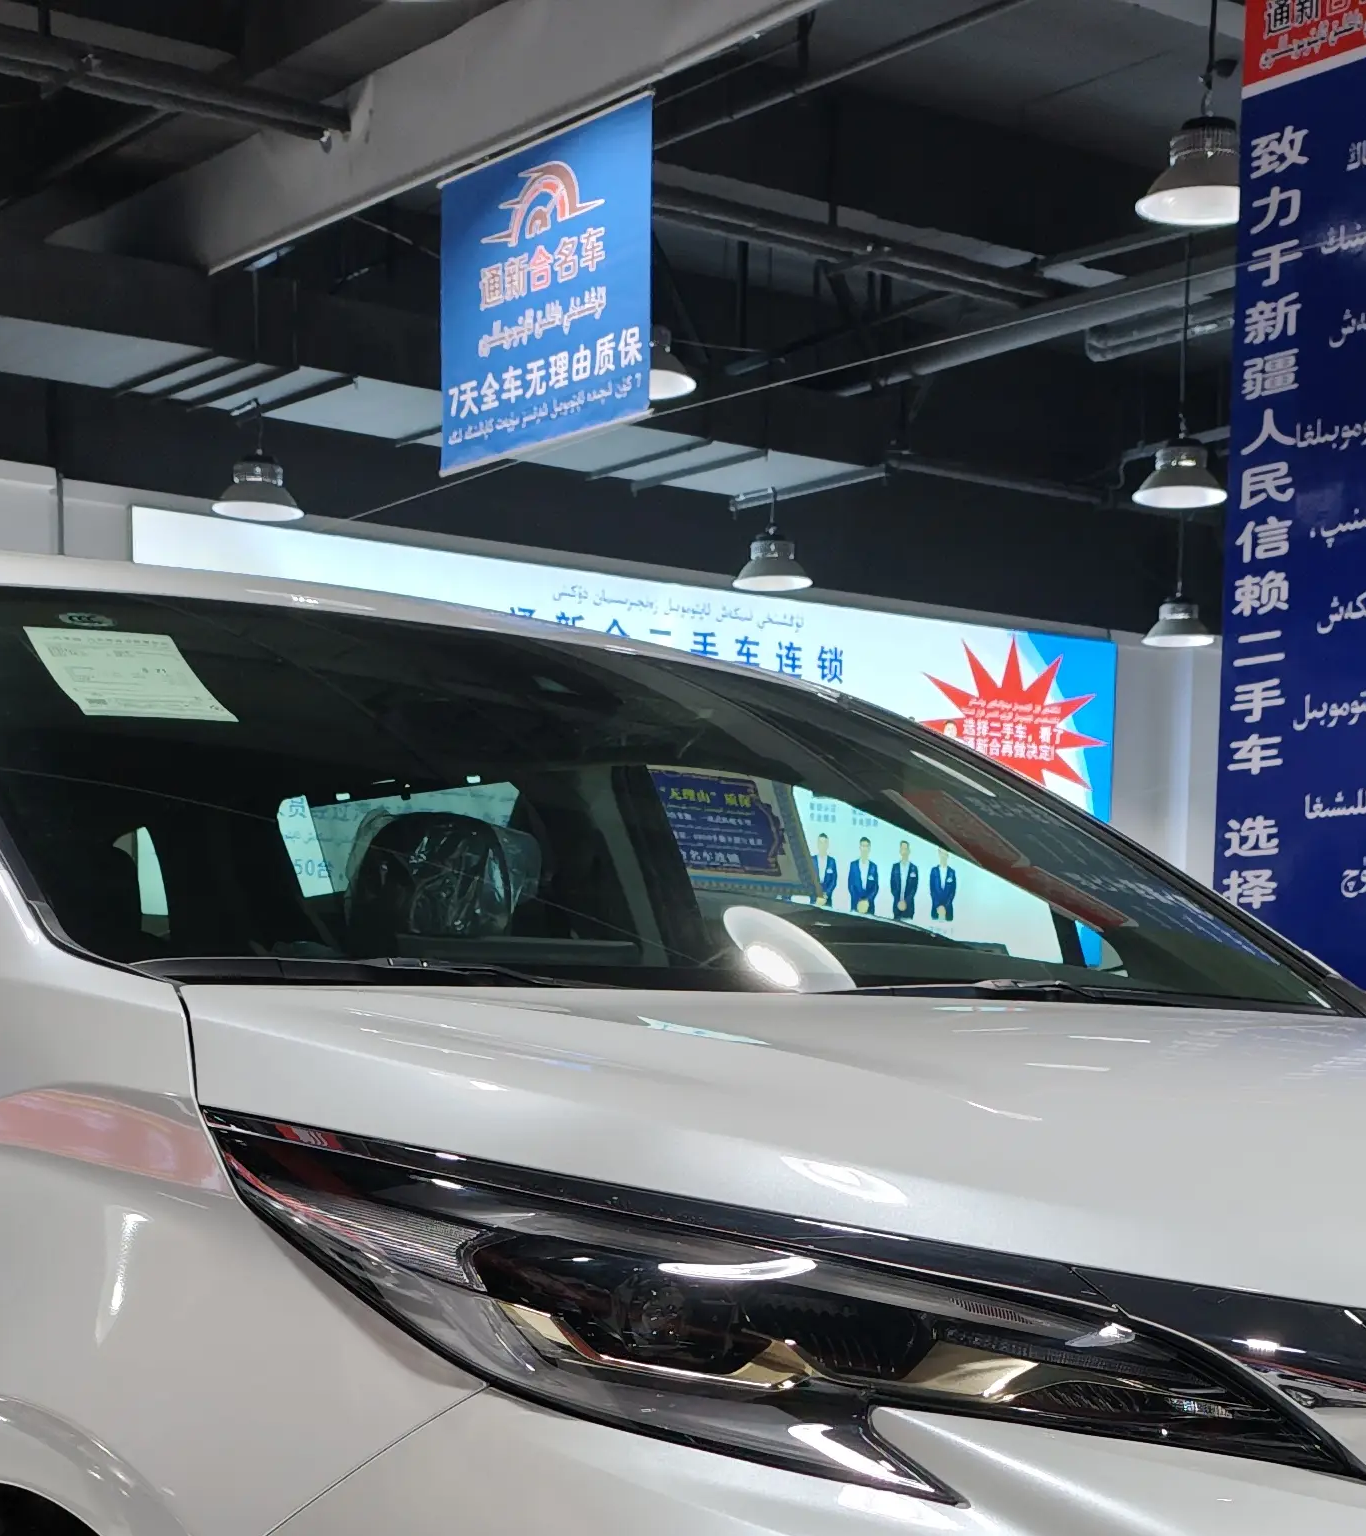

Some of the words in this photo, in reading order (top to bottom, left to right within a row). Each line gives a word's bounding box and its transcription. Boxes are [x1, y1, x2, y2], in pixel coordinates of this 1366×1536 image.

[448, 326, 643, 420] 7天全车无理由质保
